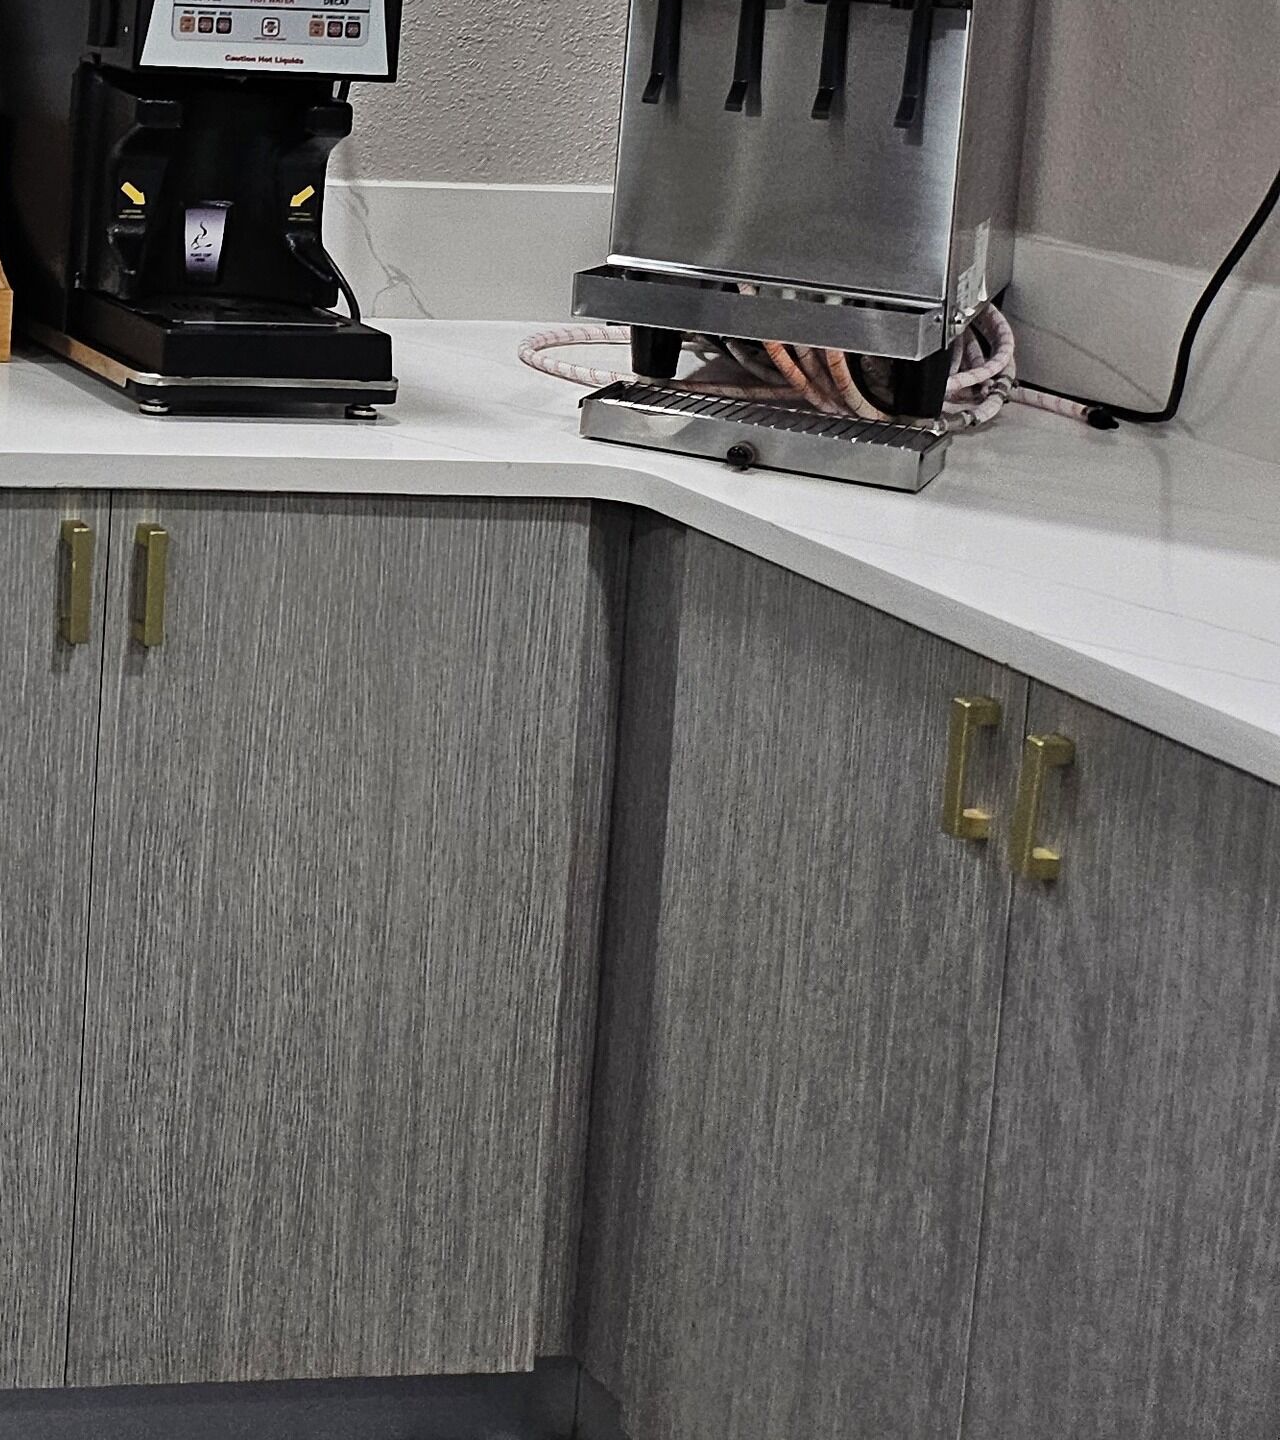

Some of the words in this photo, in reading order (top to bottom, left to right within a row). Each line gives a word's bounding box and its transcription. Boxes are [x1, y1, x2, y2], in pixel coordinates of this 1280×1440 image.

[225, 54, 256, 63] Caution
[258, 55, 272, 63] Hot
[275, 56, 304, 65] Liquids
